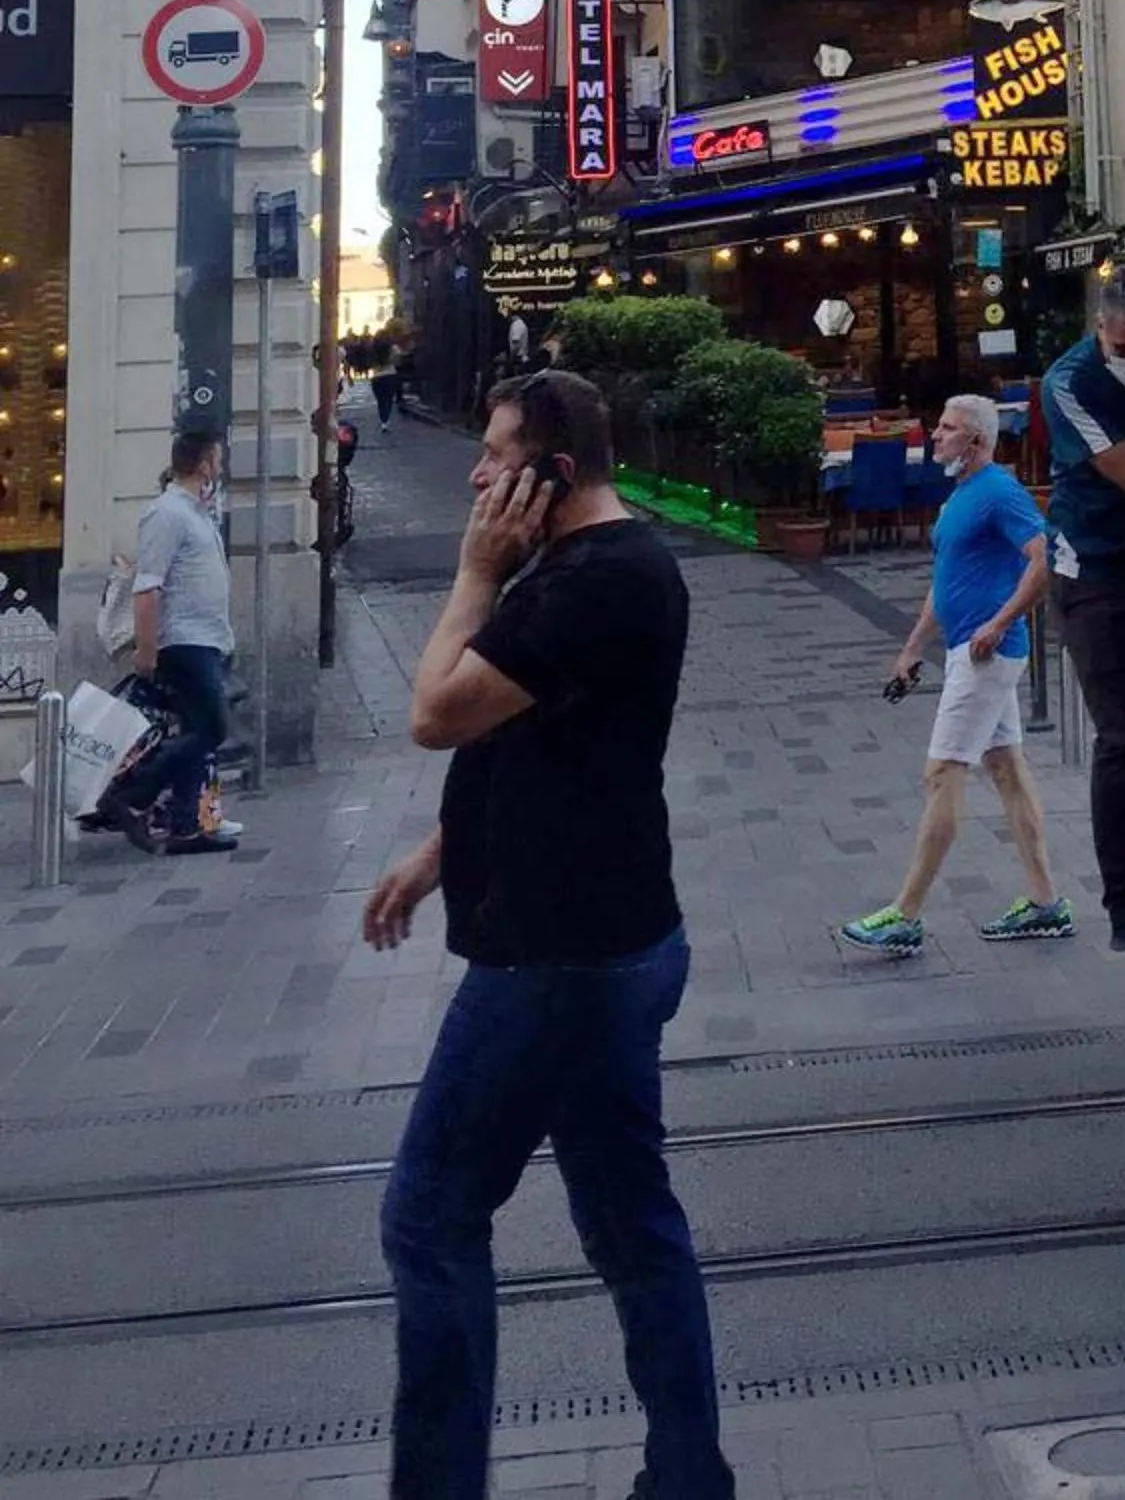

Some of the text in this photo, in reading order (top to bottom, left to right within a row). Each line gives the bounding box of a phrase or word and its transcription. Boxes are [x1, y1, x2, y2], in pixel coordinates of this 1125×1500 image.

[483, 27, 515, 49] çin
[983, 25, 1062, 80] FISH
[576, 79, 606, 171] MARA
[692, 125, 765, 160] Cafe
[952, 129, 1067, 158] STEAKS
[963, 159, 1060, 187] KEBAP
